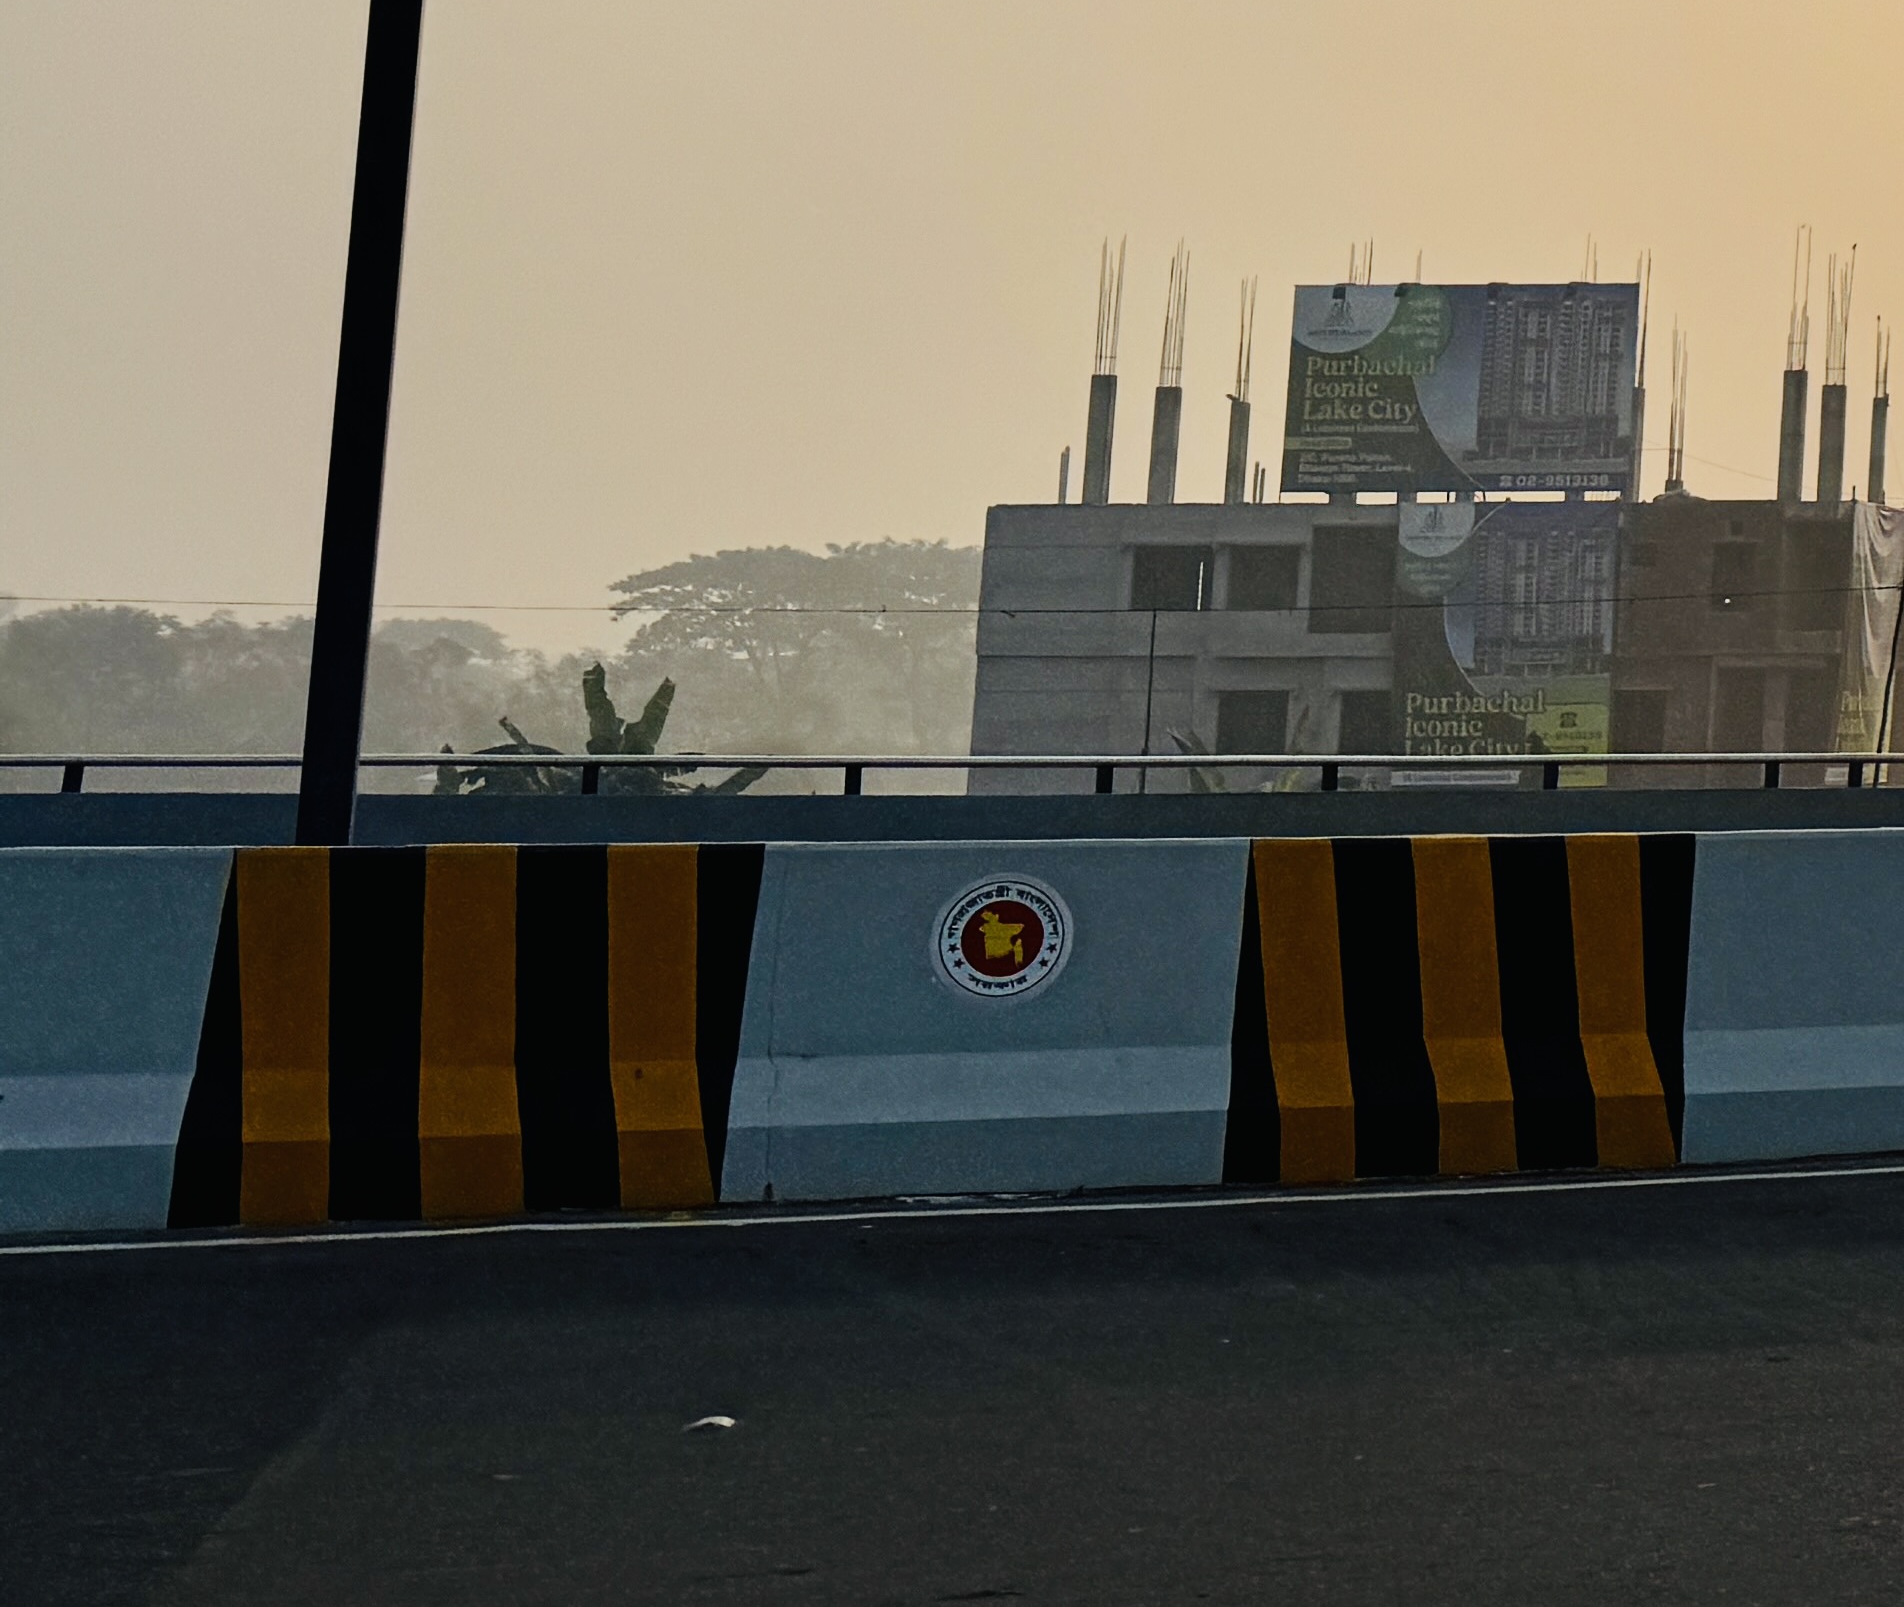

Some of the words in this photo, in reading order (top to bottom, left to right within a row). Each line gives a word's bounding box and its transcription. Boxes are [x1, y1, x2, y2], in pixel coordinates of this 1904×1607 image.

[1306, 354, 1435, 376] Purbachal
[1304, 376, 1380, 398] Iconic
[1303, 399, 1363, 421] Lake
[1368, 398, 1418, 425] City
[1406, 688, 1545, 714] Purbachal
[1405, 715, 1483, 738] Iconic
[1404, 738, 1464, 755] Lake
[1468, 737, 1517, 755] City
